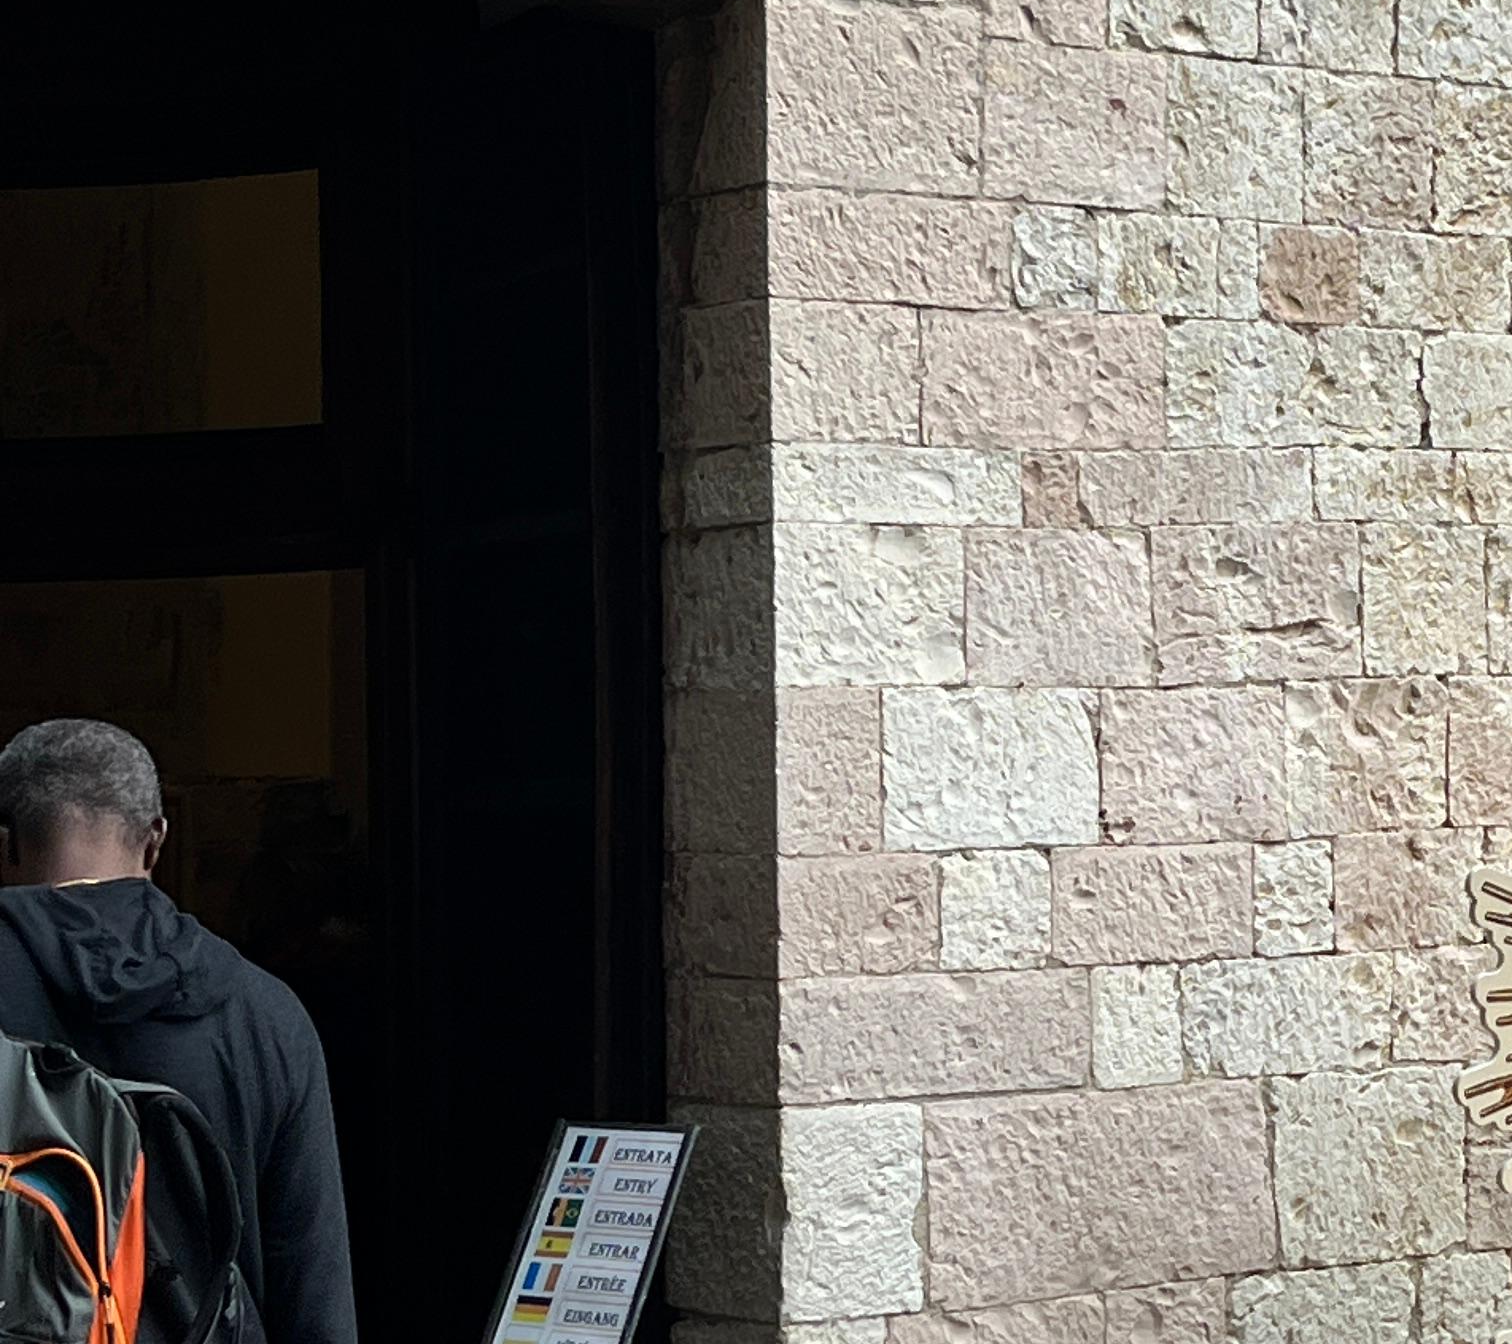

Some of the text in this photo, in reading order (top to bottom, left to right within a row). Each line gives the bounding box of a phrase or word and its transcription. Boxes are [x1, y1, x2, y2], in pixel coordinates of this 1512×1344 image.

[613, 1147, 673, 1165] ENTRATA
[614, 1178, 658, 1194] ENTRY
[594, 1210, 652, 1227] ENTRADA
[589, 1243, 640, 1260] ENTRAR
[577, 1274, 627, 1292] ENTRÉE
[563, 1309, 619, 1327] EINGANG
